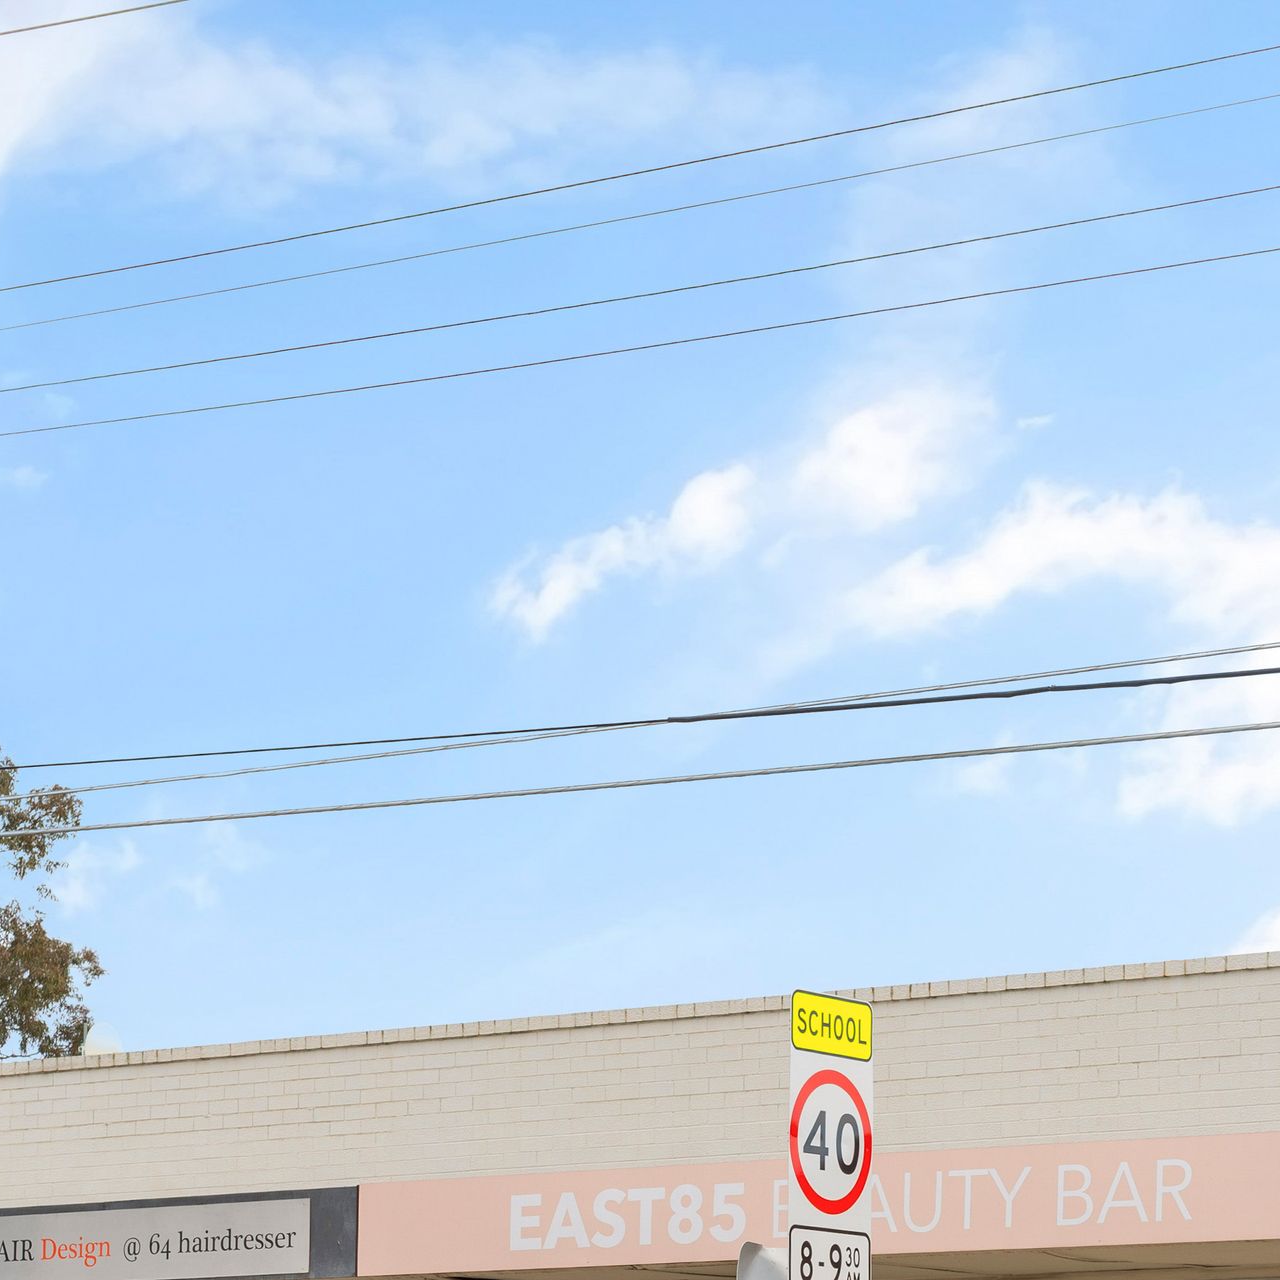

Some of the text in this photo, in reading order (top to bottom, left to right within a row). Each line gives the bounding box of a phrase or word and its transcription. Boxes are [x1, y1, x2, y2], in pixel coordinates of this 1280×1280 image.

[797, 1008, 867, 1045] SCHOOL
[803, 1110, 860, 1175] 40
[509, 1158, 1193, 1251] EAST85 AUTY BAR
[41, 1236, 111, 1268] Design
[124, 1237, 141, 1262] @
[149, 1233, 171, 1261] 64
[178, 1228, 297, 1254] hairdresser
